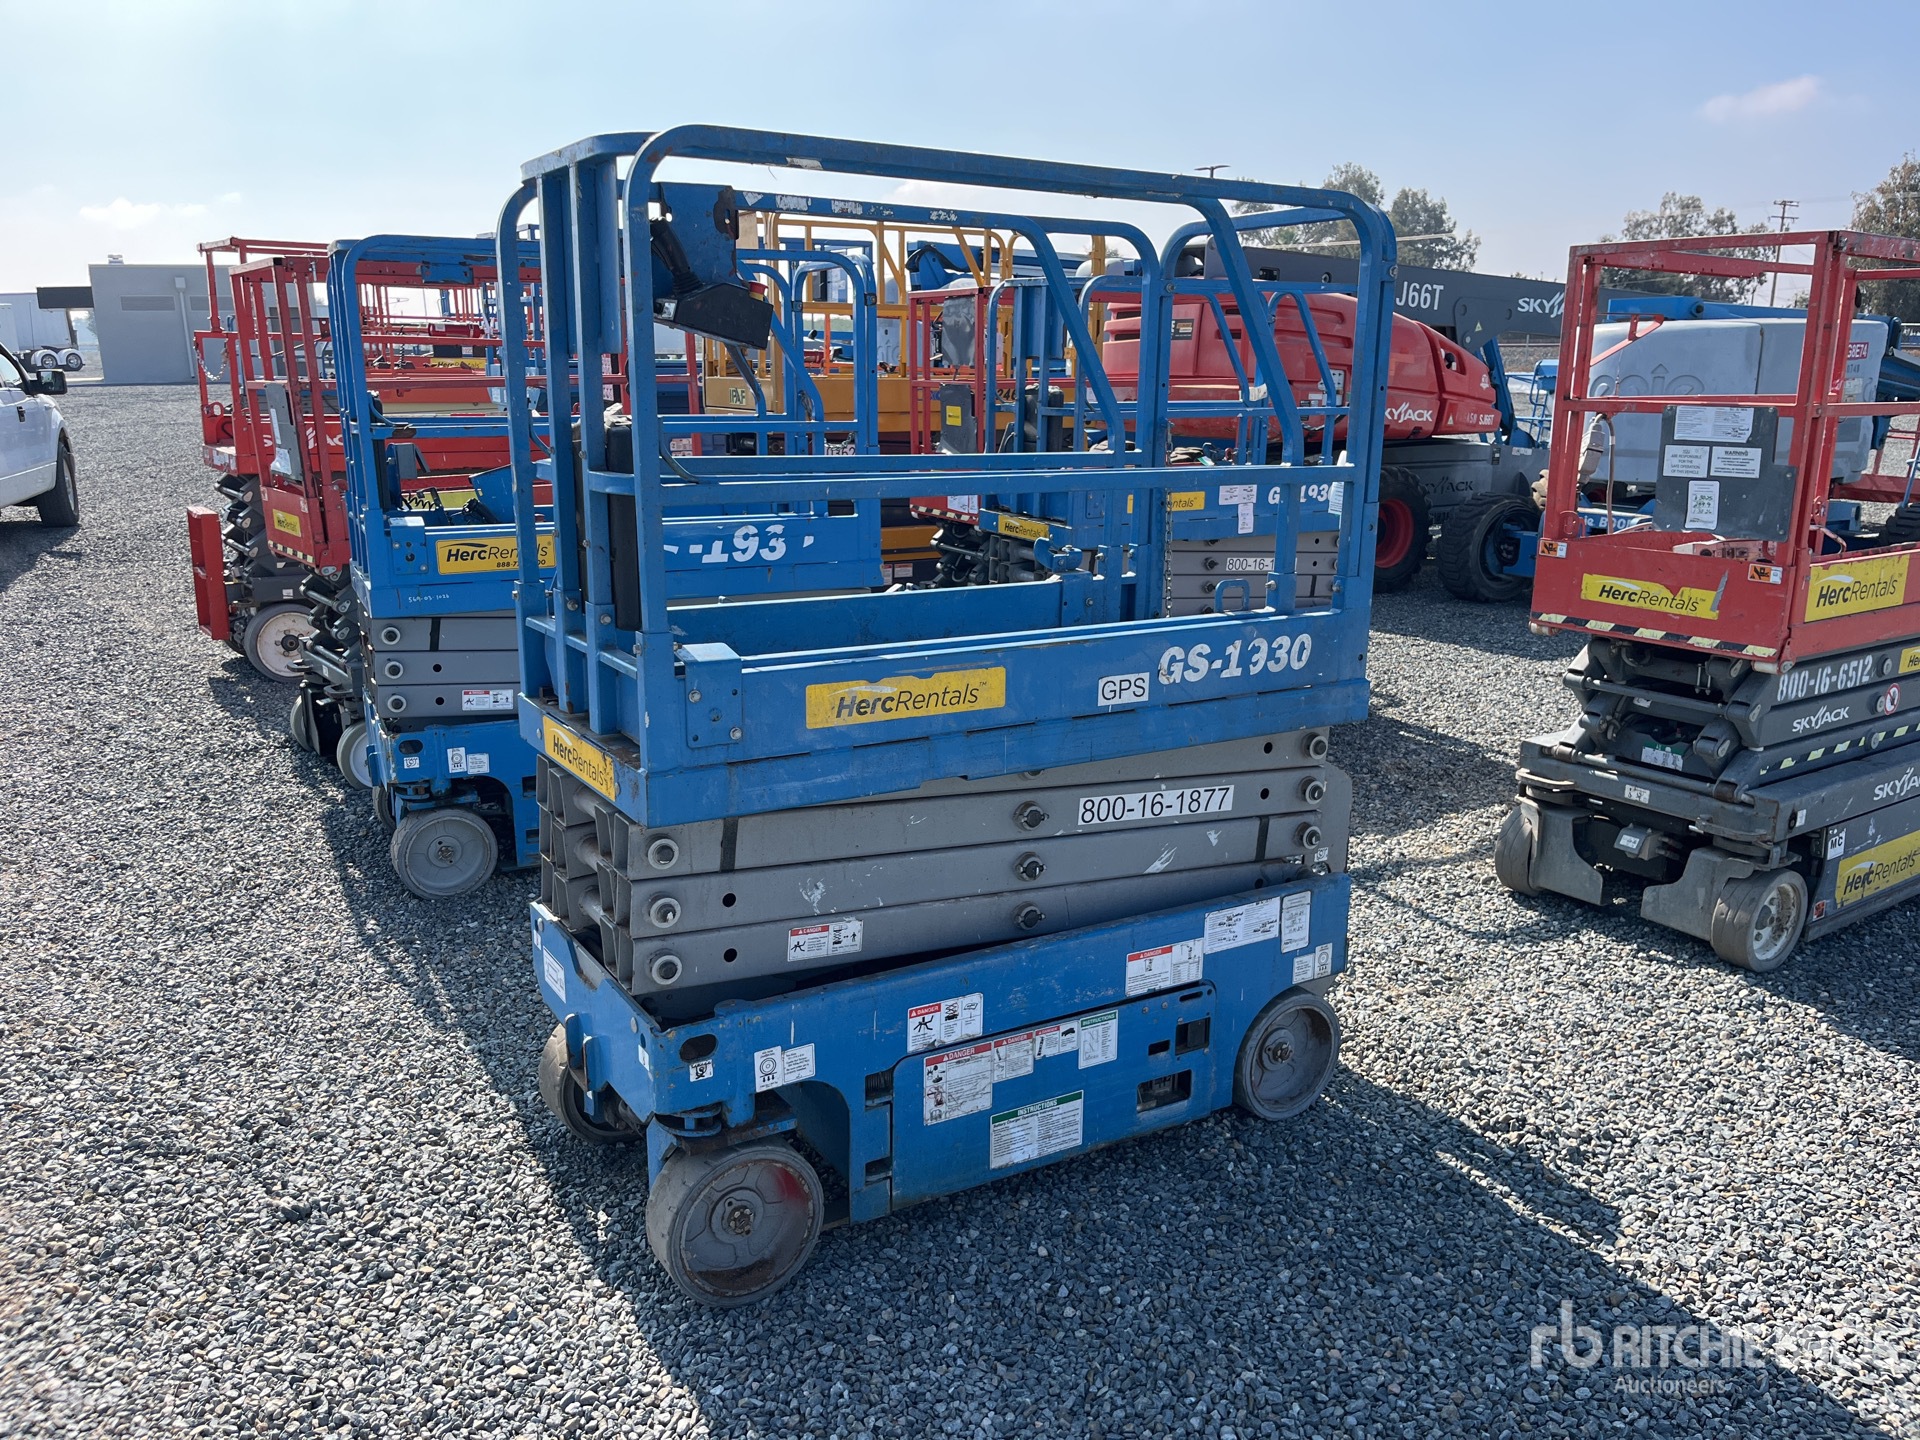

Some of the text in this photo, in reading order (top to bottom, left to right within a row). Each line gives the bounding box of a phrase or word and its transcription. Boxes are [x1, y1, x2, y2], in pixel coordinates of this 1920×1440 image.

[446, 543, 548, 562] HercRenls
[1101, 677, 1146, 700] GPS
[1777, 655, 1873, 702] 800-16-6512
[1792, 705, 1850, 733] SKYJACK
[1873, 766, 1920, 801] SKYJA
[1081, 787, 1230, 824] 800-16-1877
[917, 1005, 939, 1015] DANGER
[1008, 1035, 1028, 1044] DANGER
[948, 1047, 975, 1060] DANGER
[1017, 1099, 1058, 1116] INSTRUCTIONS
